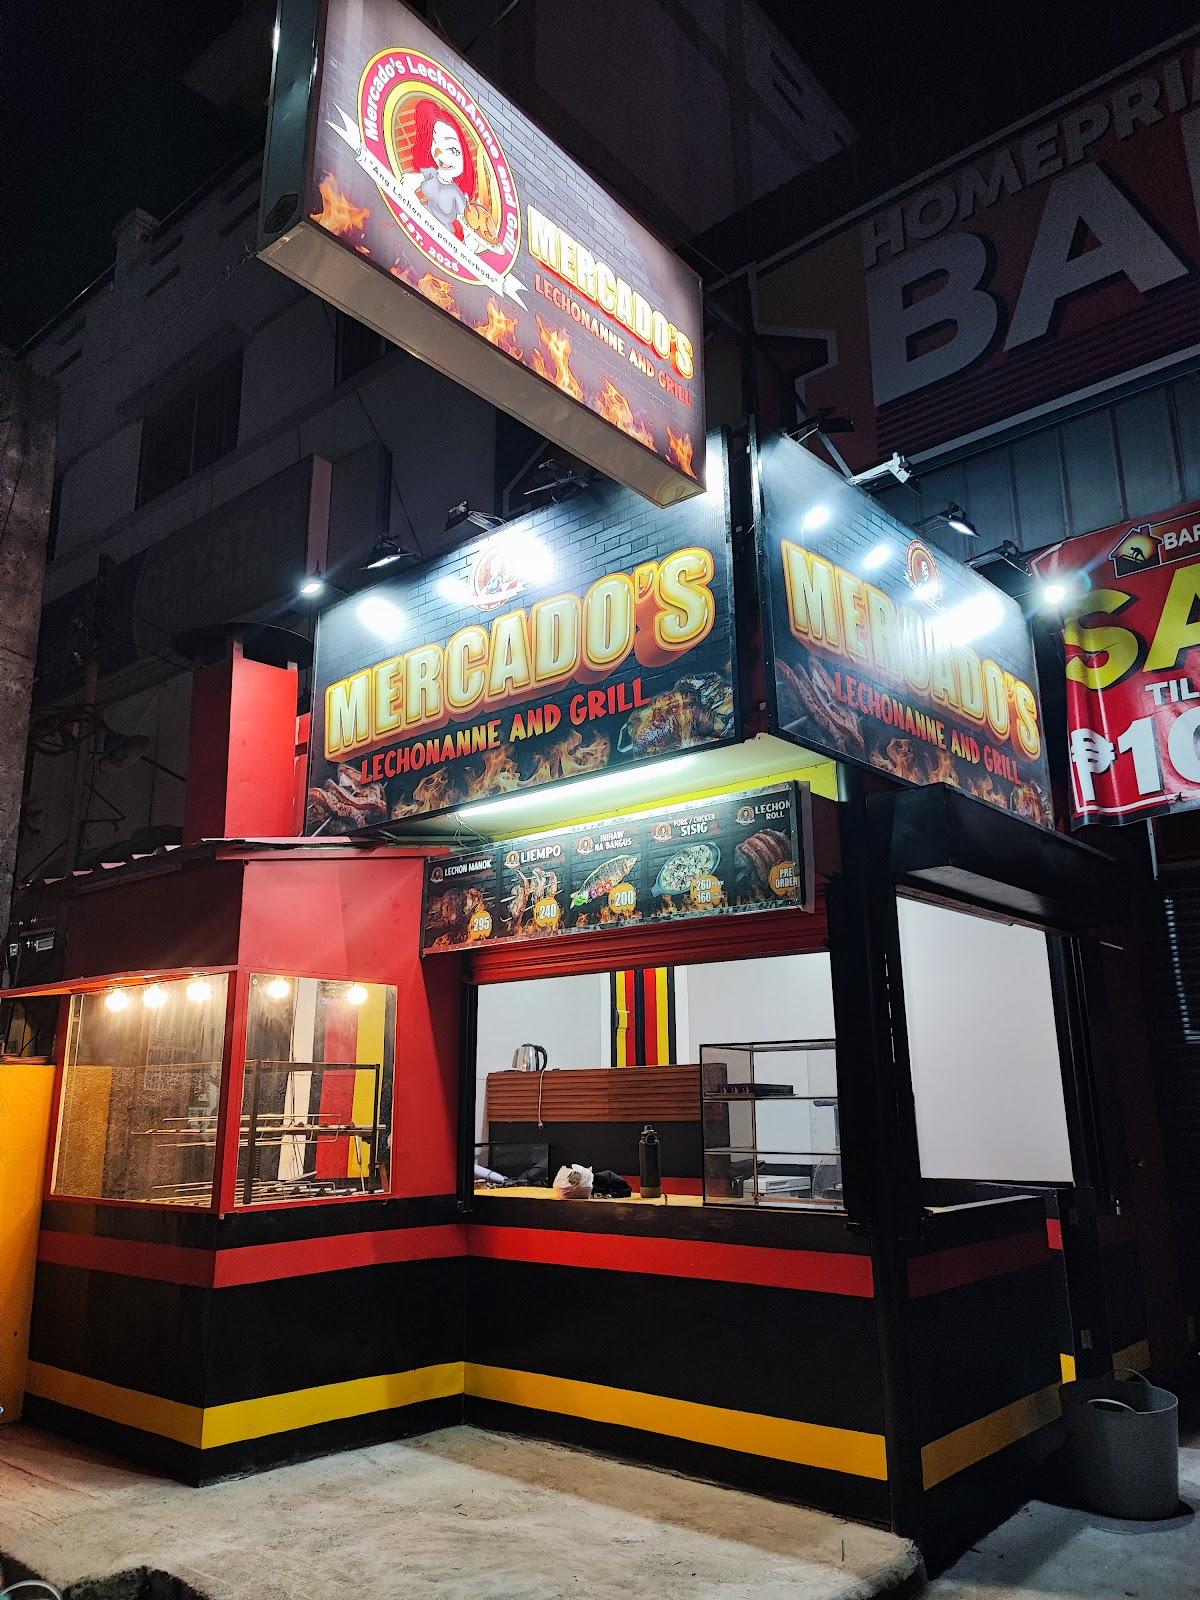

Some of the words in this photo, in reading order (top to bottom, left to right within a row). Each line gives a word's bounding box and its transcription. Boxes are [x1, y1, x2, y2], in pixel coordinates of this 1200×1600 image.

[364, 57, 406, 143] Mercado's
[865, 45, 1200, 270] HOMEPRI
[497, 165, 518, 209] and
[392, 185, 422, 222] Lechon
[437, 231, 458, 254] pang
[501, 211, 519, 256] Grill
[399, 211, 425, 247] EST.
[427, 245, 460, 273] 2025
[866, 108, 1200, 409] BA
[527, 203, 695, 381] MERCADO'S
[534, 273, 627, 358] LECHONANNE
[628, 347, 656, 378] AND
[657, 369, 694, 409] GRILL
[325, 546, 716, 757] MERCADO'S
[360, 720, 502, 785] LECHONANNE
[509, 703, 561, 742] AND
[570, 676, 651, 724] GRILL
[834, 671, 947, 750] LECHONANNE
[951, 731, 982, 764] AND
[983, 743, 1022, 785] GRILL
[754, 799, 791, 814] LECHON
[765, 810, 784, 820] ROLL
[594, 843, 604, 852] NA
[605, 837, 632, 850] BANGUS
[680, 821, 708, 837] SISIG
[444, 863, 467, 877] LECHON
[468, 858, 492, 872] MANOK
[520, 844, 561, 864] LIEMPO
[615, 890, 634, 906] 200
[696, 879, 711, 891] 260
[697, 891, 711, 904] 160
[775, 876, 798, 889] ORDER
[473, 916, 490, 932] 295
[539, 904, 557, 920] 240
